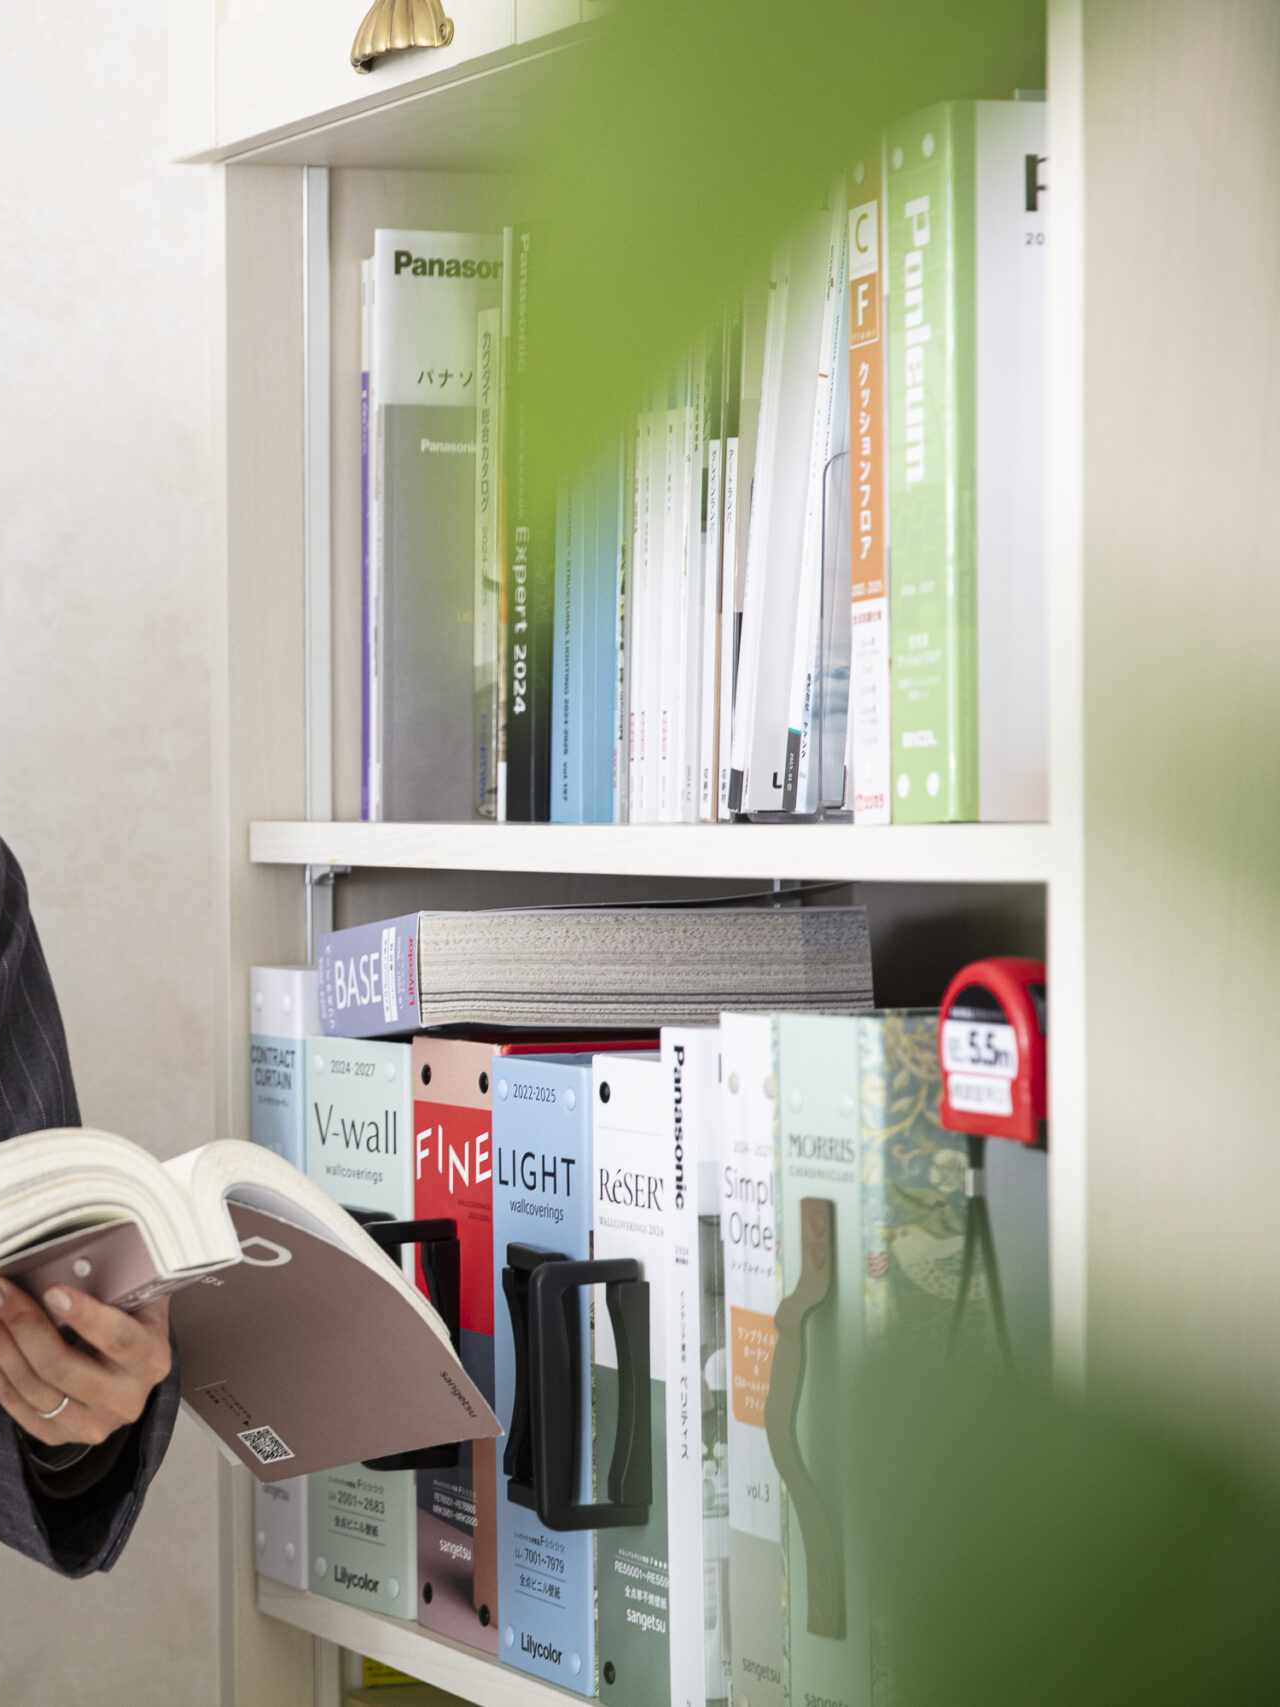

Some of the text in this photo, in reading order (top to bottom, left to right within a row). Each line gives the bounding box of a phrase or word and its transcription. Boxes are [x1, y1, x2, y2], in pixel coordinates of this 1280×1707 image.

[855, 213, 868, 253] C
[857, 283, 868, 326] F
[513, 526, 529, 634] Expert
[513, 644, 528, 715] 2024
[334, 952, 382, 1009] BASE
[408, 937, 416, 1006] Lilycolor
[250, 1045, 296, 1069] CONTRACT
[255, 1068, 292, 1090] CURTAIN
[314, 1102, 398, 1155] V-wall
[673, 1045, 685, 1210] Panasonic
[416, 1124, 492, 1195] FINE
[787, 1133, 855, 1163] MORRIS
[325, 1164, 383, 1184] wallcoverings
[498, 1146, 576, 1197] LIGHT
[509, 1198, 564, 1224] wallcoverings
[440, 1370, 477, 1419] sangetsu
[746, 1482, 770, 1503] vol.3
[439, 1538, 471, 1561] sangetsu
[334, 1564, 379, 1593] Lilycolor
[626, 1608, 666, 1634] sangetsu
[520, 1631, 563, 1665] Lilycolor
[742, 1656, 781, 1685] sangetsu
